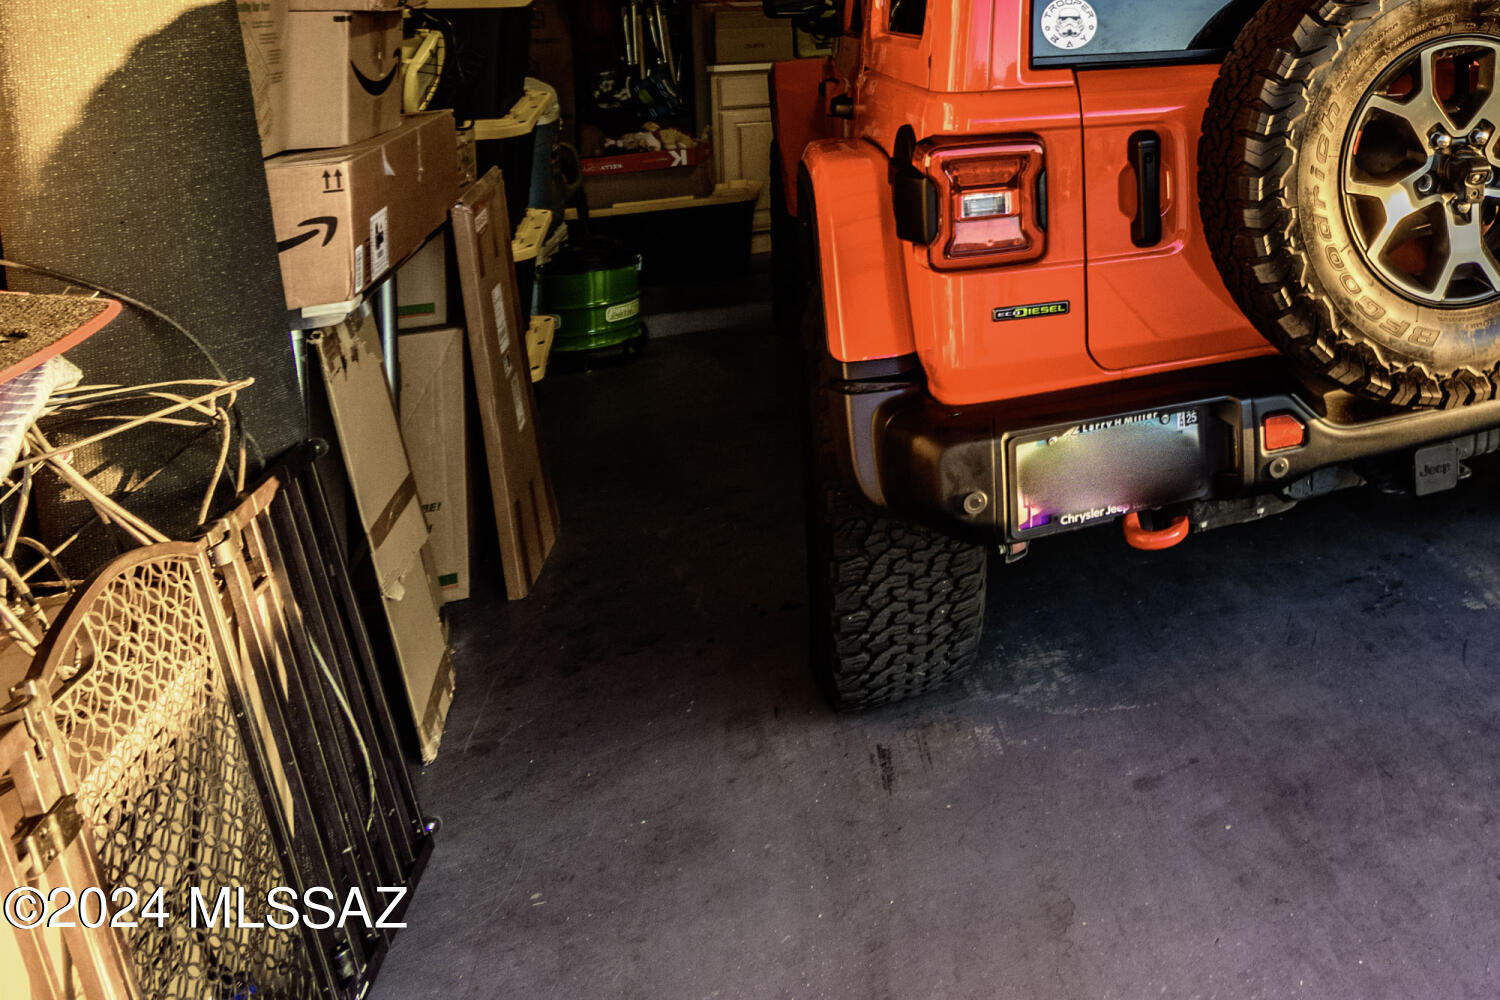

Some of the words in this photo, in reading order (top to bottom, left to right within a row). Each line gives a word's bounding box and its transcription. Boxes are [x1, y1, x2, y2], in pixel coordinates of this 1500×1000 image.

[669, 149, 688, 167] K
[1082, 420, 1112, 432] Larry
[1114, 418, 1122, 426] H
[1124, 412, 1158, 425] Miller
[1186, 411, 1198, 424] 25
[1419, 463, 1451, 477] Jeep
[1060, 507, 1104, 525] Chrysler
[1105, 504, 1130, 516] Jeep
